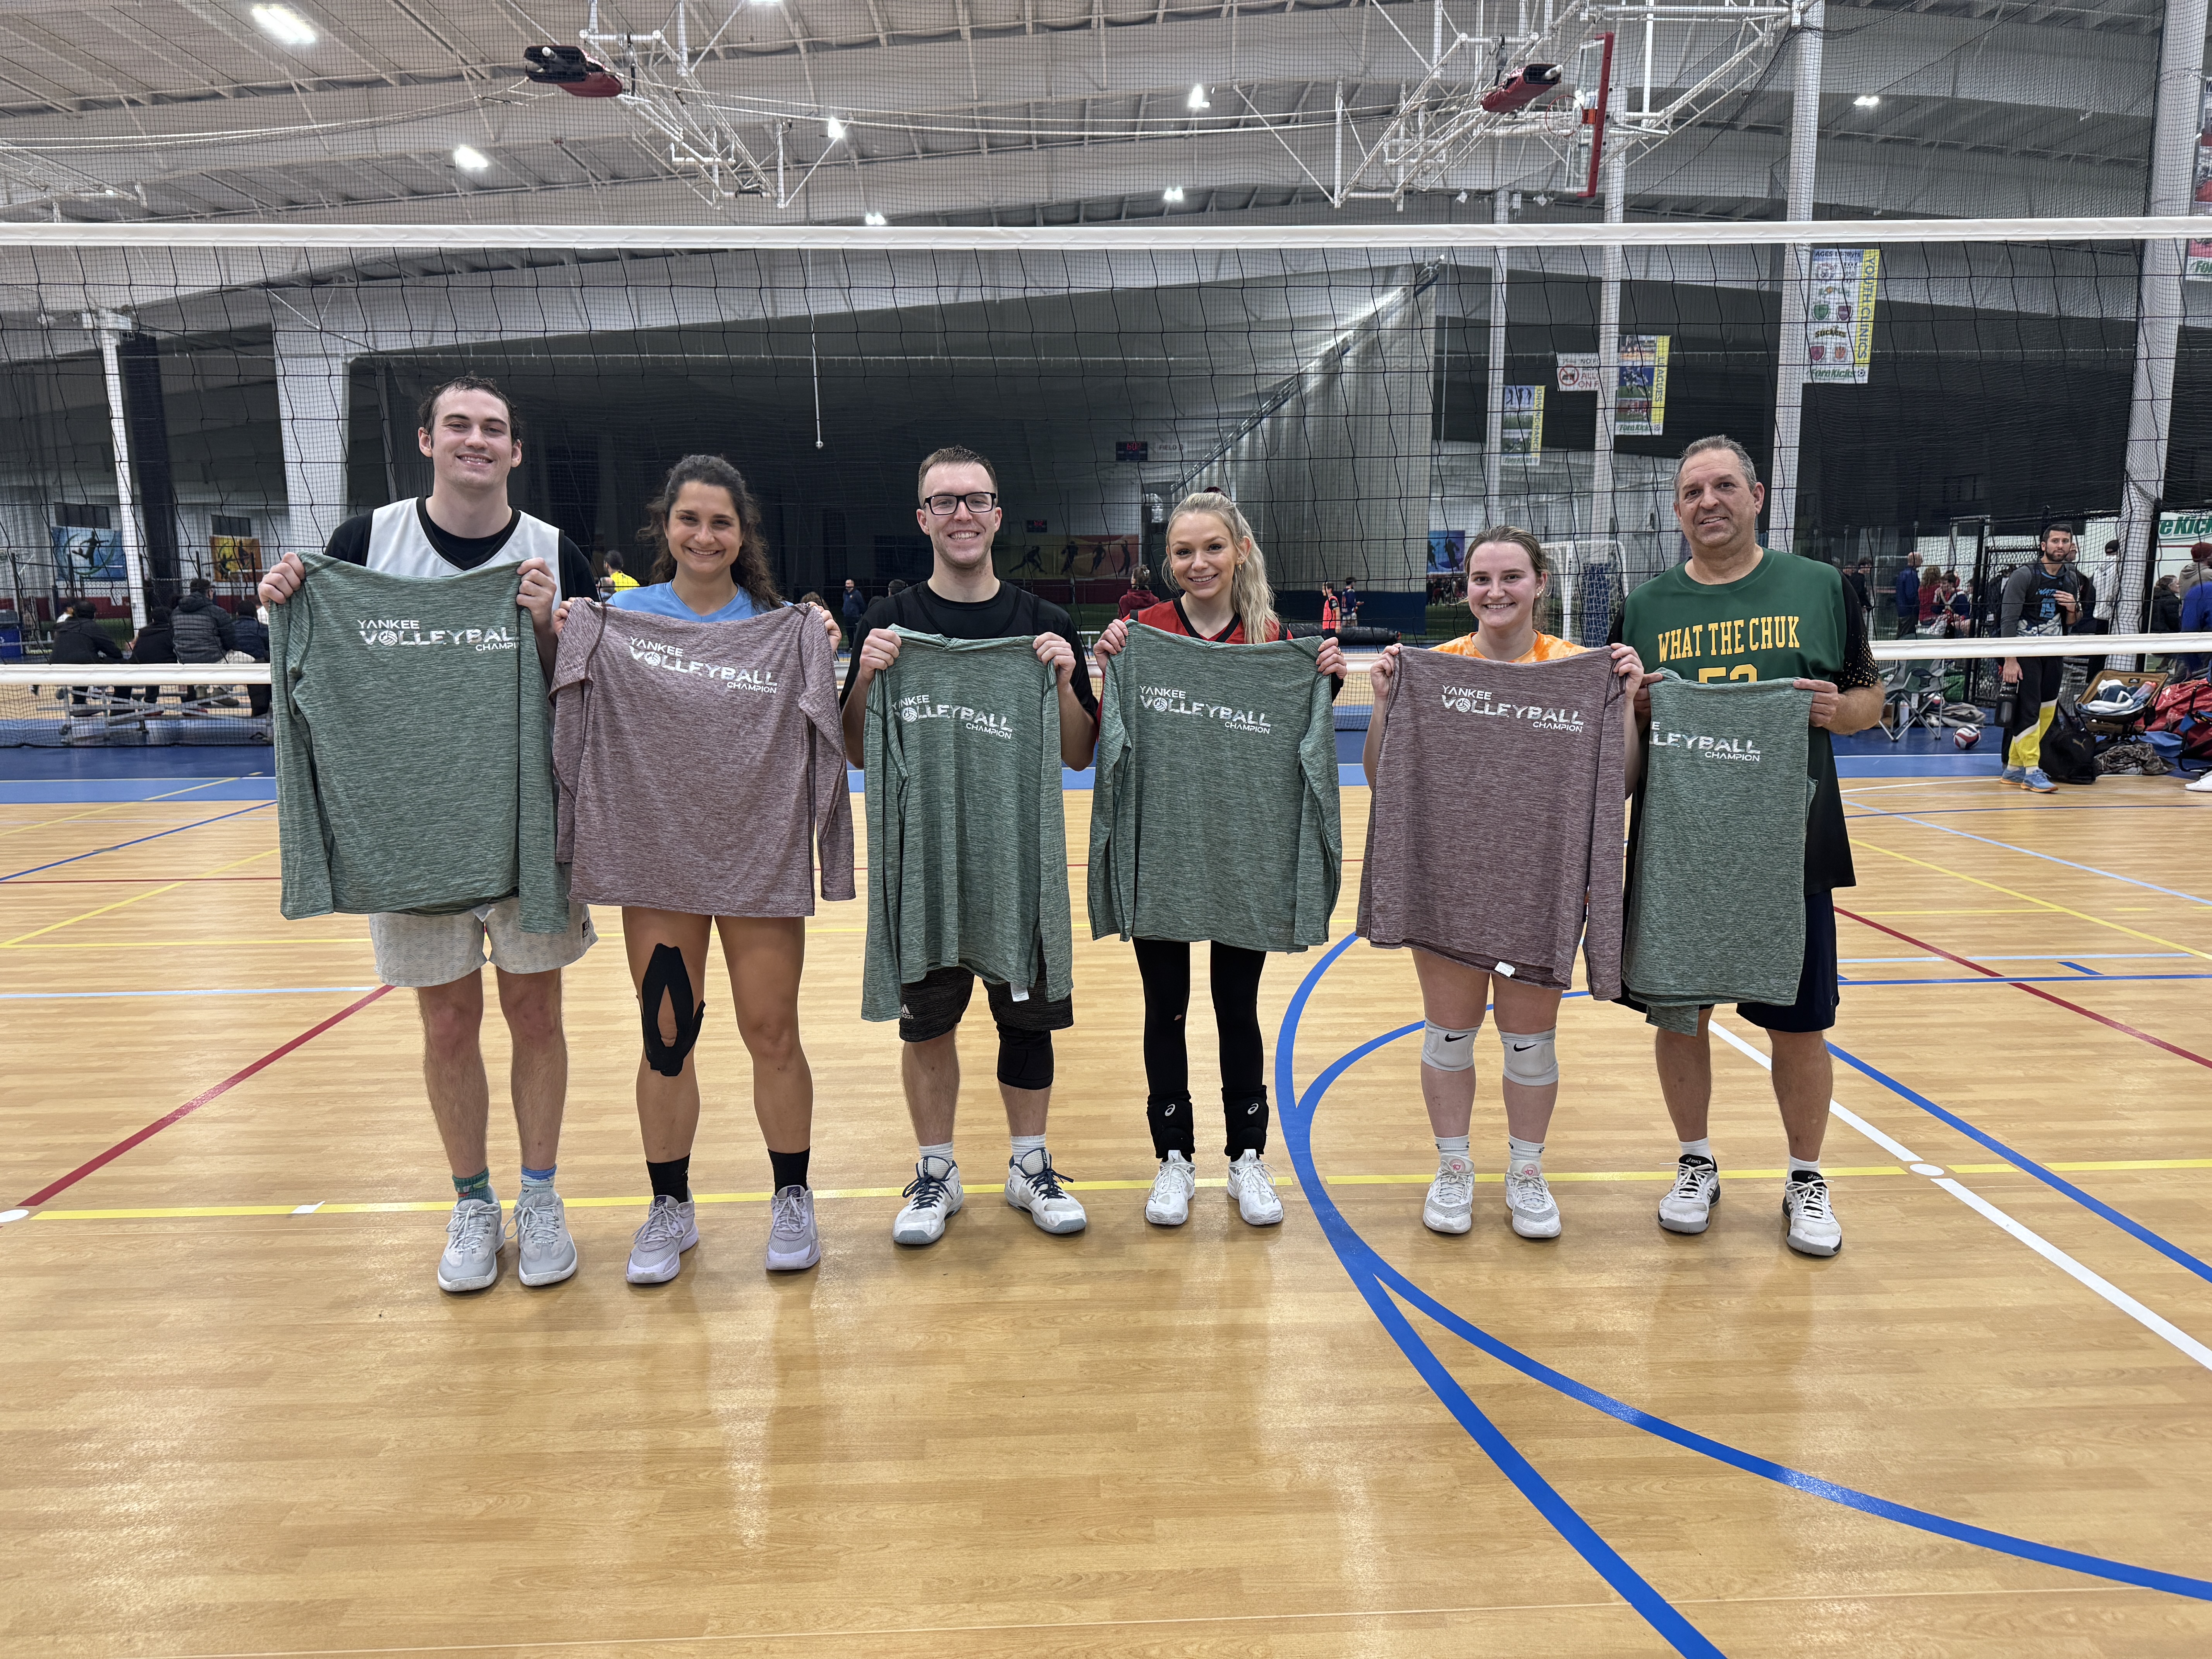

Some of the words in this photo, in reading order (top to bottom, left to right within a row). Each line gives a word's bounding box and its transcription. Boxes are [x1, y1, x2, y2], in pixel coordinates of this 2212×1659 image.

[1863, 256, 1876, 303] YOUTH
[1858, 307, 1871, 359] CLINICS
[1656, 357, 1665, 402] LEAGUES
[1534, 389, 1542, 422] DRIVNG
[357, 620, 420, 629] YANKEE
[476, 642, 518, 651] CHAMPI
[630, 636, 684, 657] YANKEE
[1658, 624, 1703, 663] WHAT
[1708, 619, 1745, 656] THE
[1749, 616, 1800, 651] CHUK
[629, 646, 778, 686] VOLLEYBALL
[727, 682, 777, 694] CHAMPION
[1140, 685, 1186, 699] YANKEE
[1442, 685, 1492, 700] YANKEE
[1140, 695, 1271, 727] VOLLEYBALL
[1441, 695, 1584, 726] VOLLEYBALL
[966, 723, 1012, 739] CHAMPION
[1224, 721, 1270, 734] CHAMPION
[1533, 721, 1583, 733] CHAMPION
[1650, 732, 1760, 754] LEYBALL
[1705, 751, 1760, 762] CHAMPION
